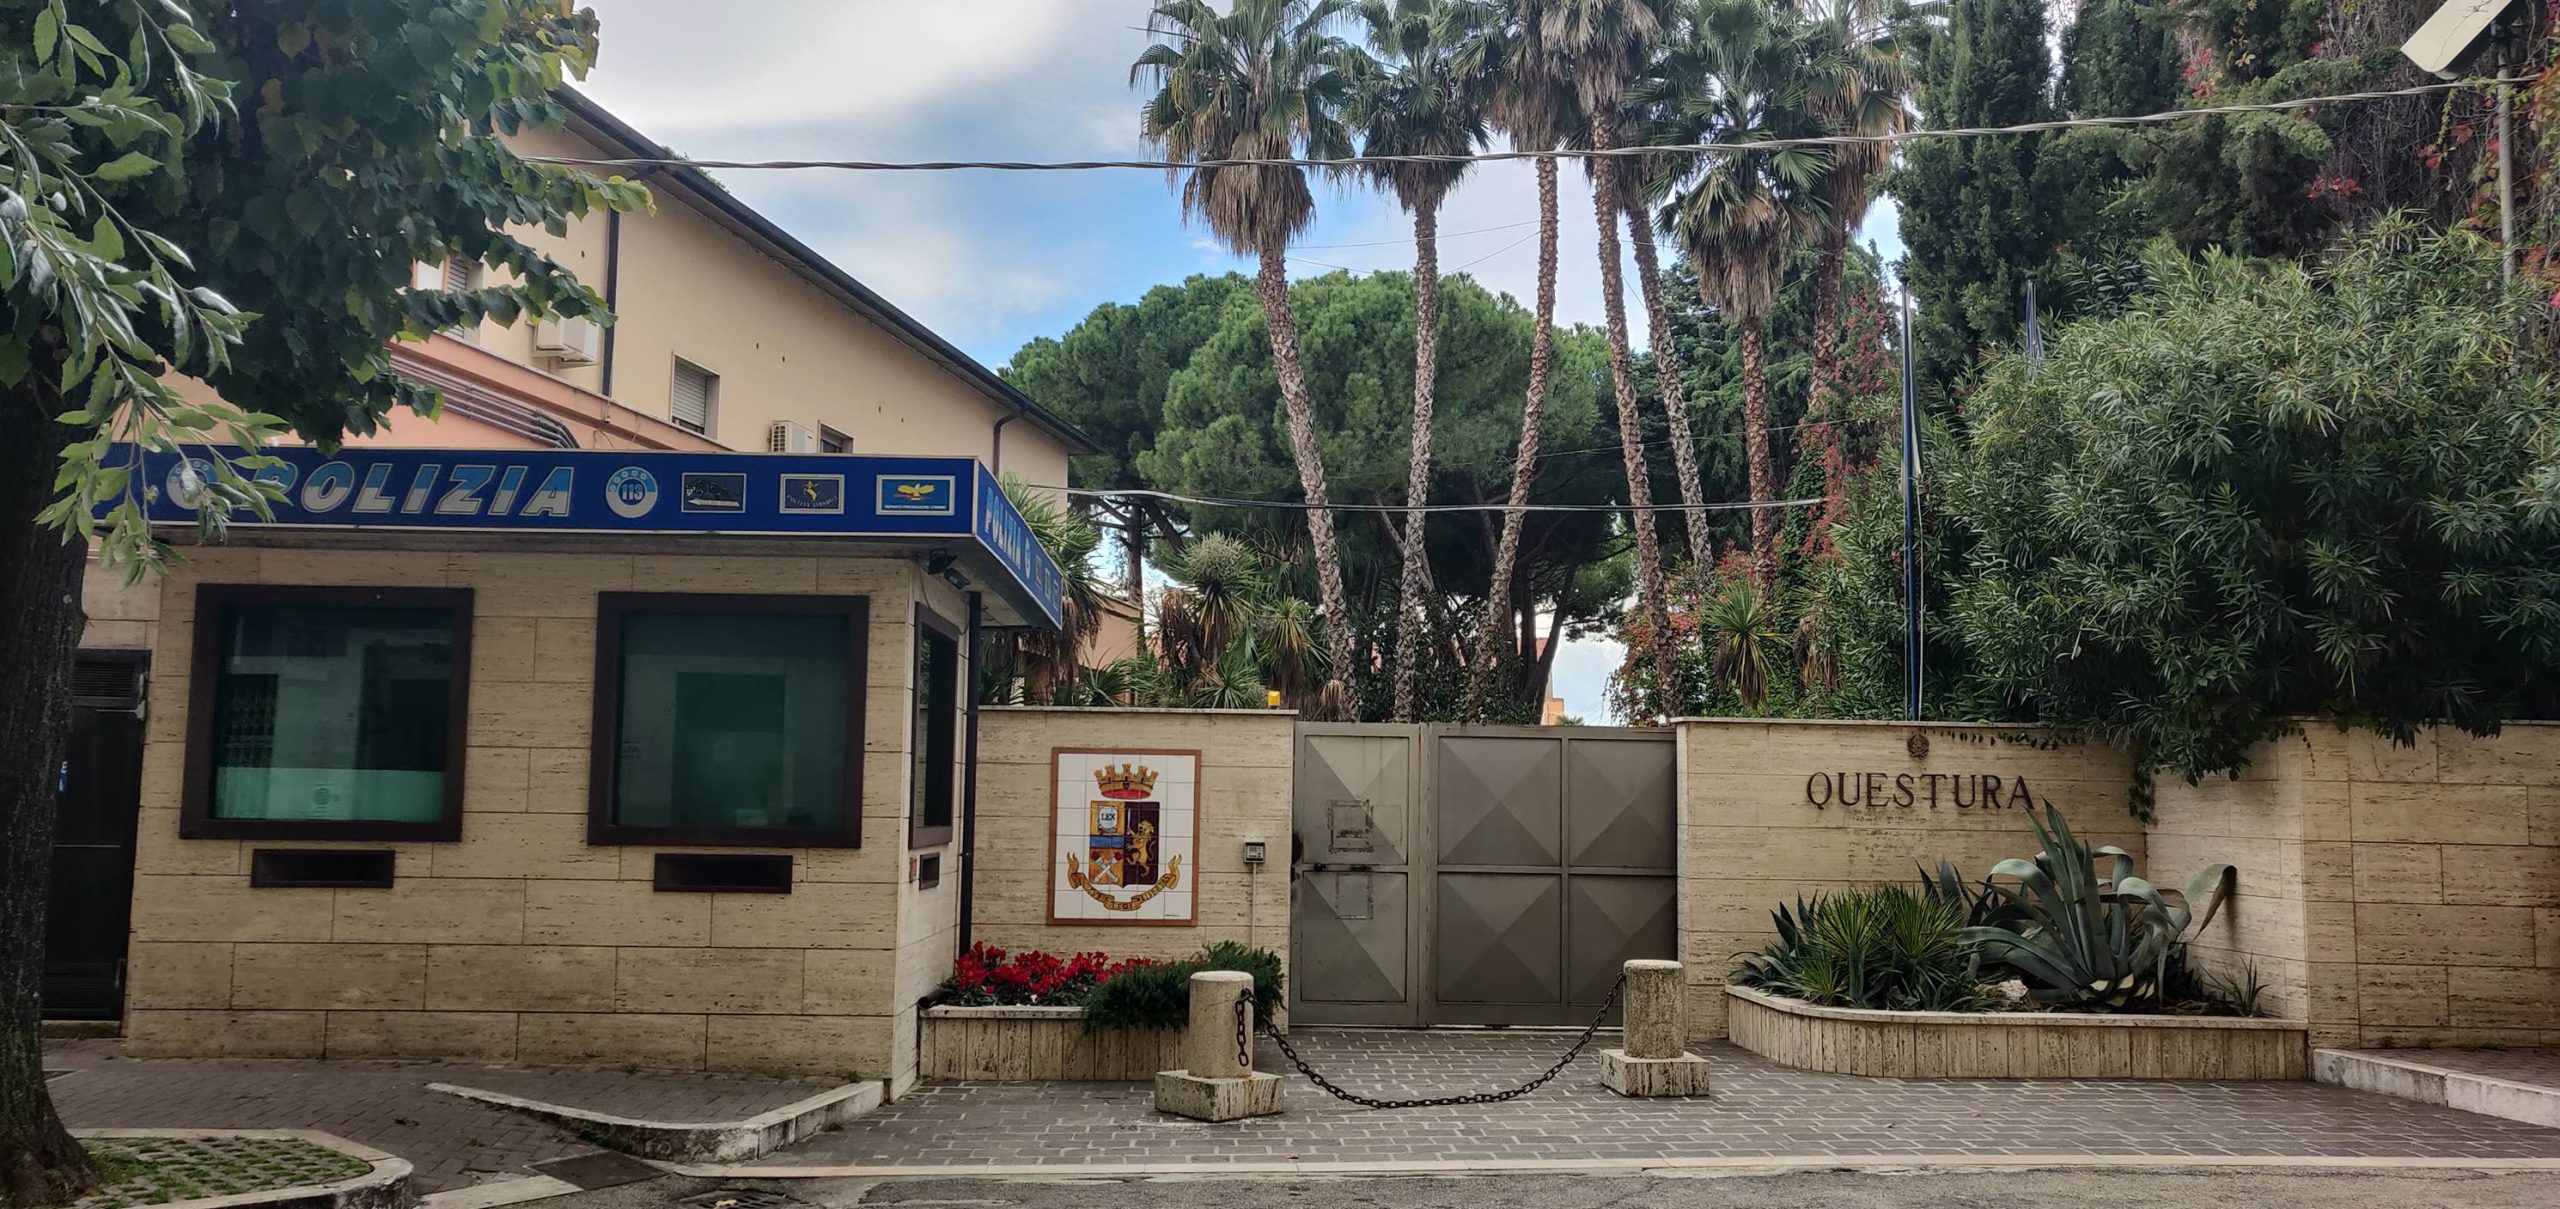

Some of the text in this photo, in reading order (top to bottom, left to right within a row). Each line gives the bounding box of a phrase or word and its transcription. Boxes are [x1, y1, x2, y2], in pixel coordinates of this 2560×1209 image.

[621, 483, 644, 500] 113
[984, 486, 1022, 570] POLIZIA
[1806, 772, 2035, 810] QUESTURA
[1101, 812, 1116, 821] LEX
